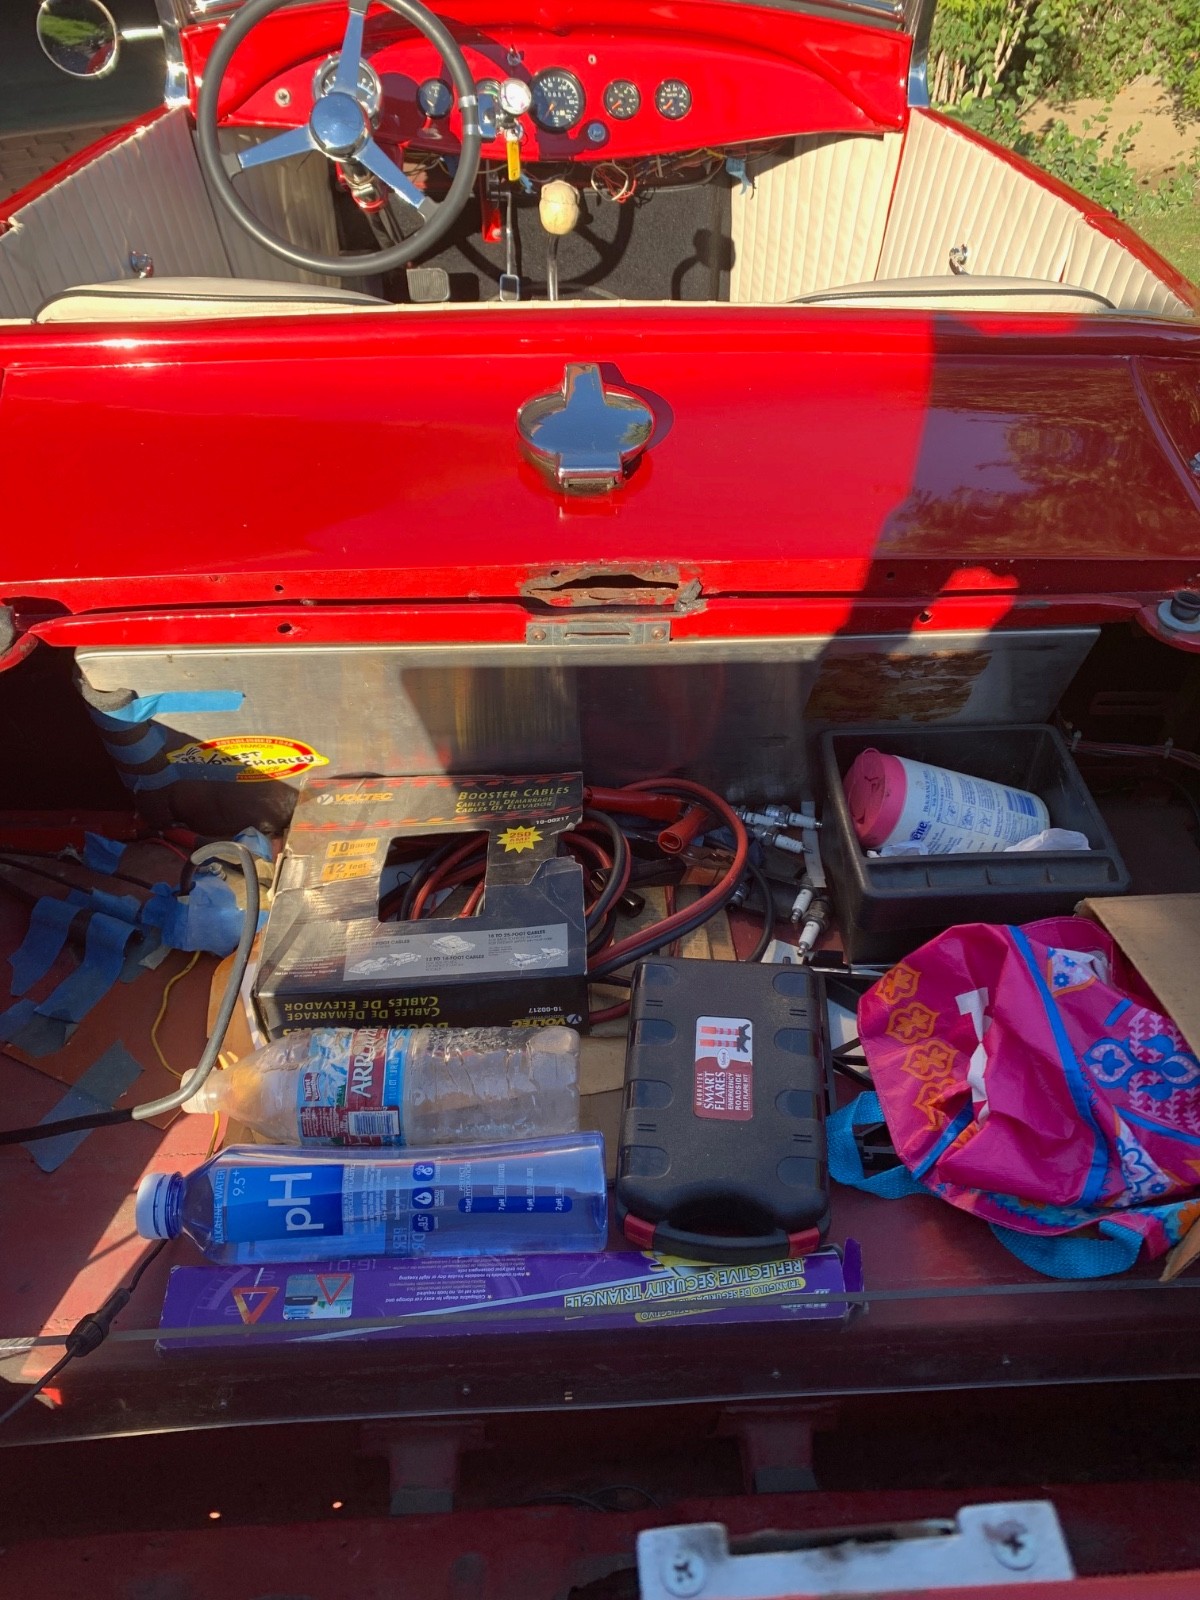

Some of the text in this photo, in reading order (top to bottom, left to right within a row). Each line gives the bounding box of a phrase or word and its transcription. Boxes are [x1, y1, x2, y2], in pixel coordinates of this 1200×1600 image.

[244, 755, 315, 768] CHARLEY
[335, 792, 395, 802] VOLTEC
[459, 786, 570, 801] BOOSTER CABLES
[455, 806, 488, 814] CABLES
[491, 804, 503, 812] DE
[535, 815, 570, 825] 10-00217
[331, 841, 350, 853] 10
[327, 862, 347, 875] 12
[284, 996, 439, 1011] CABLES DE ELEVADOR
[528, 1006, 562, 1014] 10-00217
[371, 1009, 389, 1018] DE
[394, 1007, 440, 1017] CABLES
[511, 1017, 566, 1028] VOLTEC
[703, 1071, 715, 1110] SMART
[714, 1071, 726, 1111] FLARES
[734, 1073, 742, 1111] ROADSIDE
[213, 1169, 226, 1244] ALKALINE WATER
[267, 1172, 325, 1232] pH
[565, 1258, 803, 1308] REFLECTIVE SECURITY TRIANGLE
[738, 1287, 751, 1298] DE
